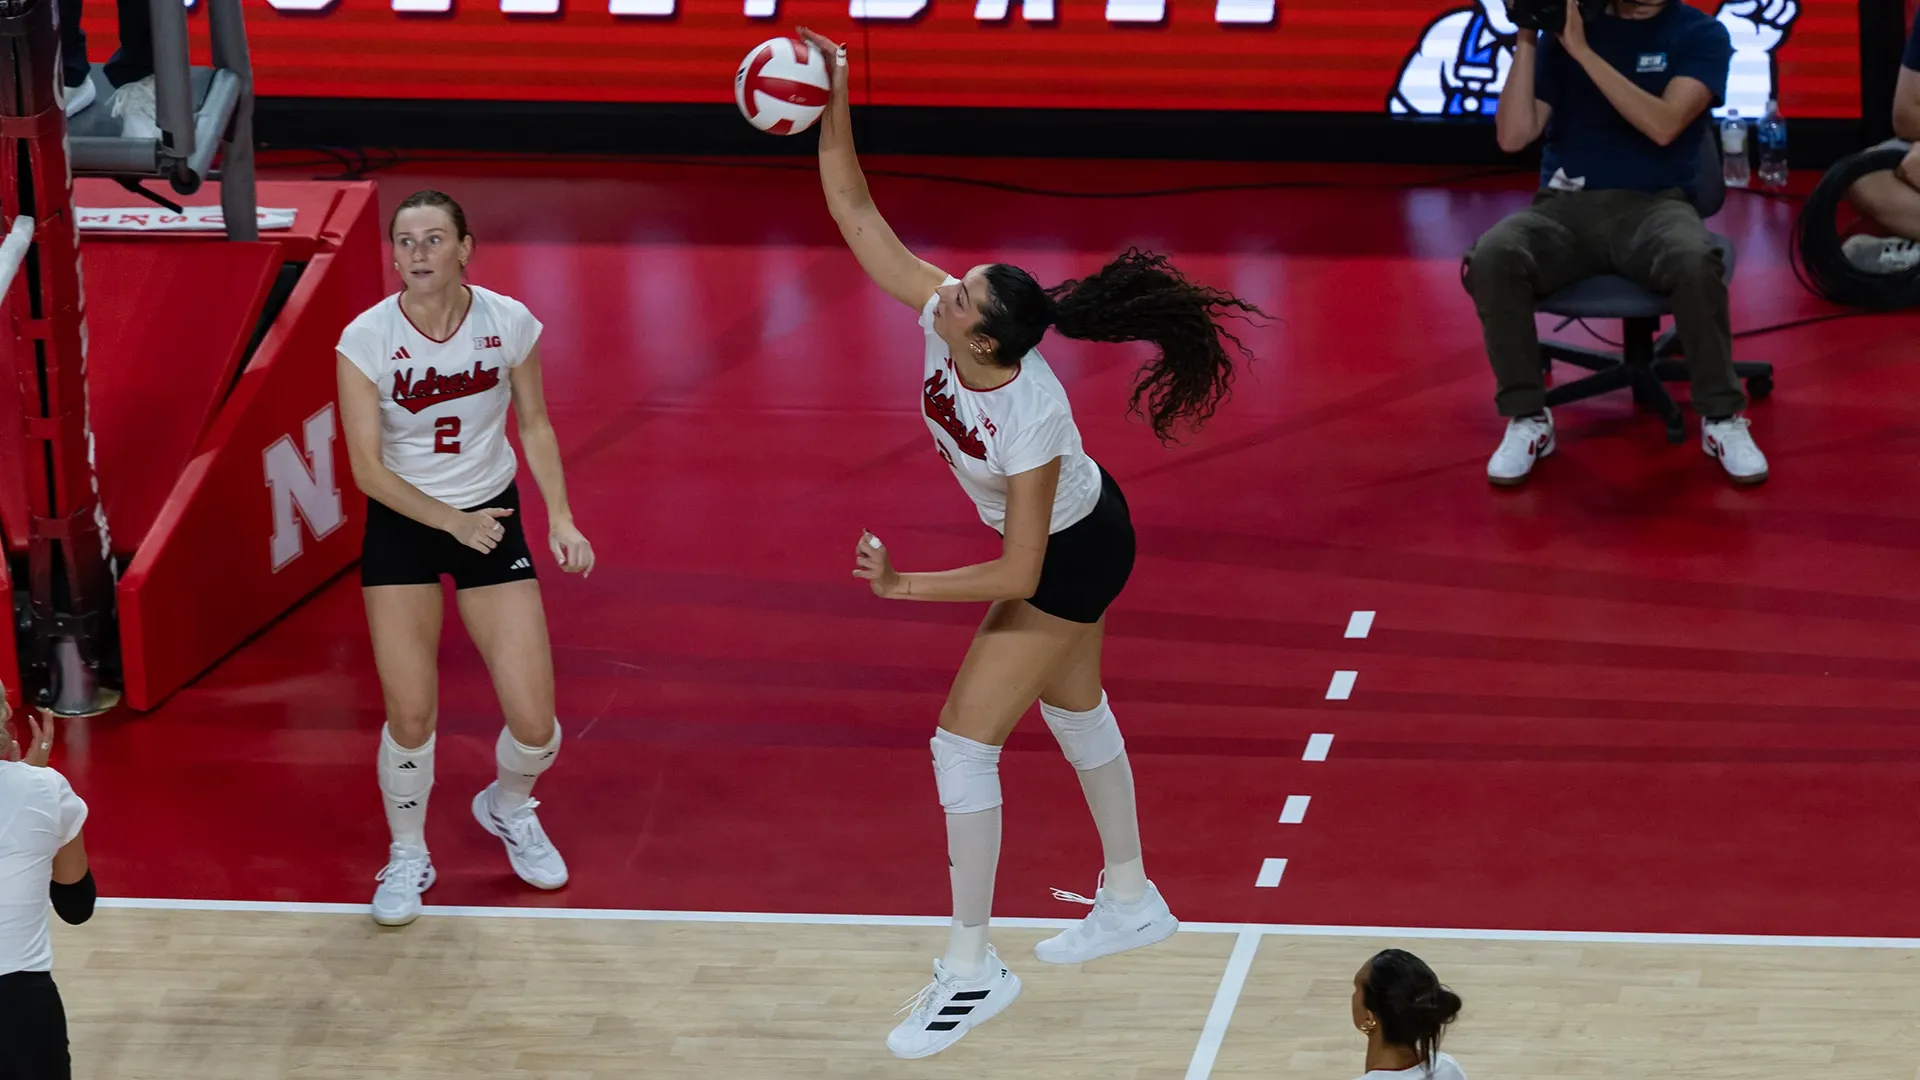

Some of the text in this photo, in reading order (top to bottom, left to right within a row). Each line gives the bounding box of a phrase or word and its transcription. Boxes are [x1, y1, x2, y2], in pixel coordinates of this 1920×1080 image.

[392, 361, 500, 402] Nebraska
[434, 416, 461, 454] 2
[262, 401, 348, 574] N
